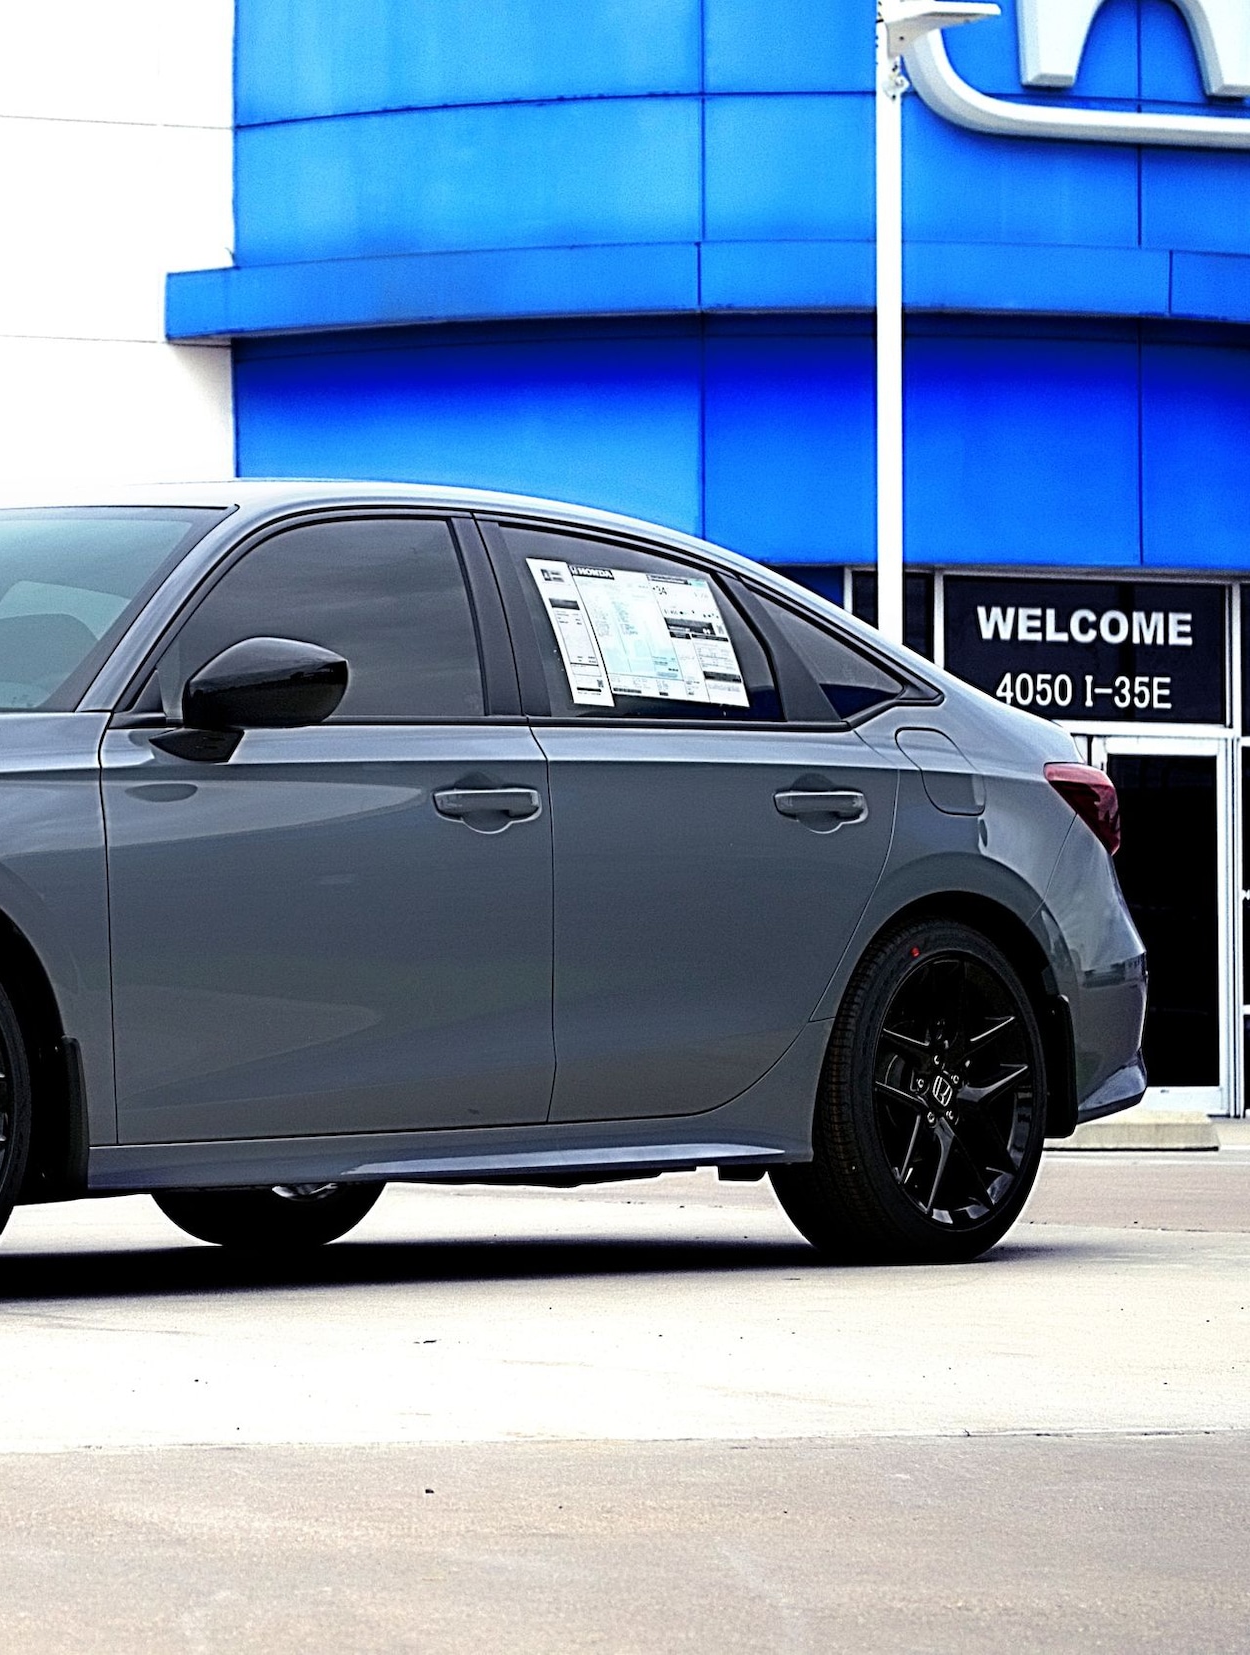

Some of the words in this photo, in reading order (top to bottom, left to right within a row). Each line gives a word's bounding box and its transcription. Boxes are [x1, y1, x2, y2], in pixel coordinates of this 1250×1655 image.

[577, 567, 612, 579] HONDA
[976, 605, 1194, 646] WELCOME
[996, 672, 1073, 706] 4050
[1084, 674, 1173, 710] I-35E
